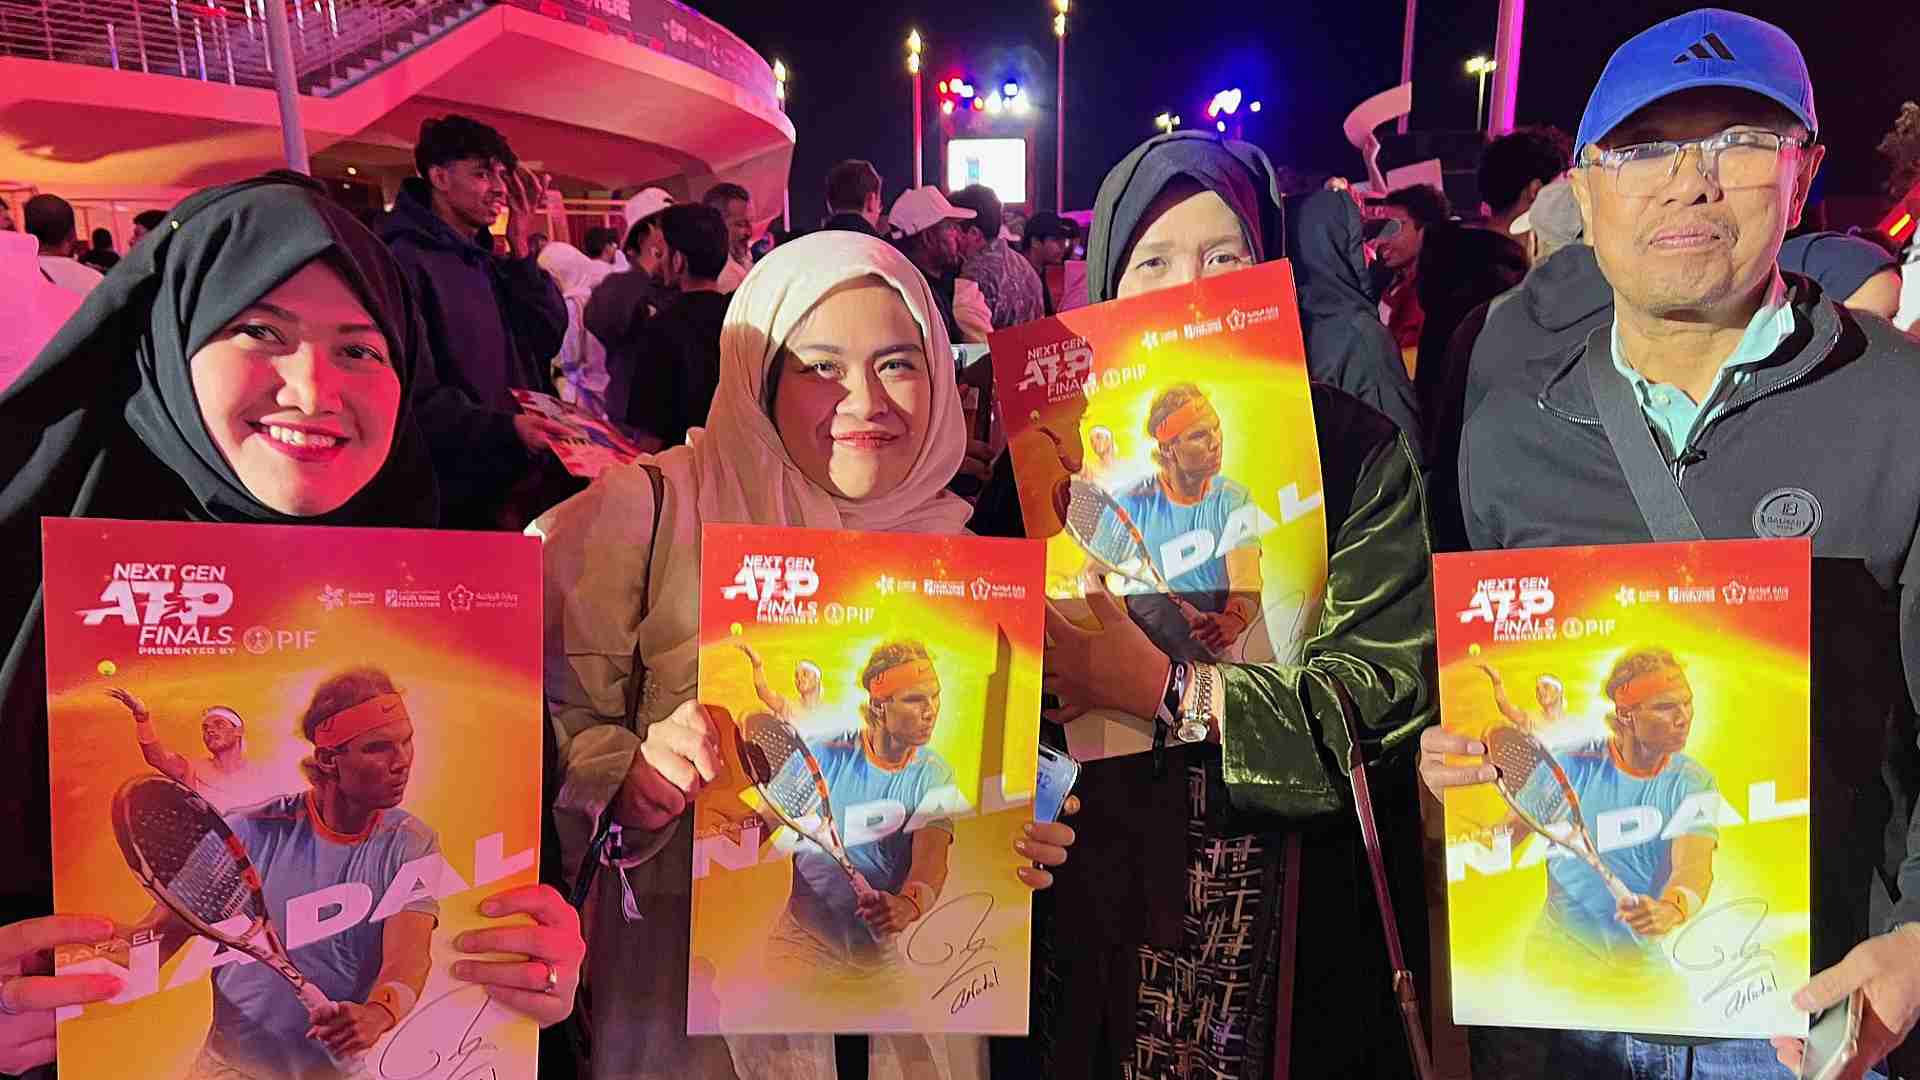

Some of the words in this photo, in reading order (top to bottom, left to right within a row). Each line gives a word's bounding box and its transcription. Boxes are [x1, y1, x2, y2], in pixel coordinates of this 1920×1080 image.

[1027, 343, 1060, 360] NEXT
[1061, 335, 1087, 351] GEN
[1016, 347, 1094, 391] ATP
[113, 563, 176, 581] NEXT
[180, 565, 226, 581] GEN
[743, 555, 783, 570] NEXT
[785, 556, 815, 571] GEN
[720, 567, 820, 601] ATP
[1477, 578, 1516, 592] NEXT
[1519, 576, 1549, 591] GEN
[75, 582, 234, 625] ATP
[757, 600, 818, 618] FINALS
[1456, 589, 1555, 624] ATP
[138, 626, 233, 645] FINALS
[1494, 618, 1556, 635] FINALS
[1585, 618, 1617, 637] PIF
[277, 630, 320, 650] PIF
[138, 647, 215, 655] PRESENTED
[219, 647, 237, 655] BY
[692, 774, 1034, 879] NADAL
[1447, 780, 1809, 882] NADAL
[56, 831, 535, 1023] NADAL
